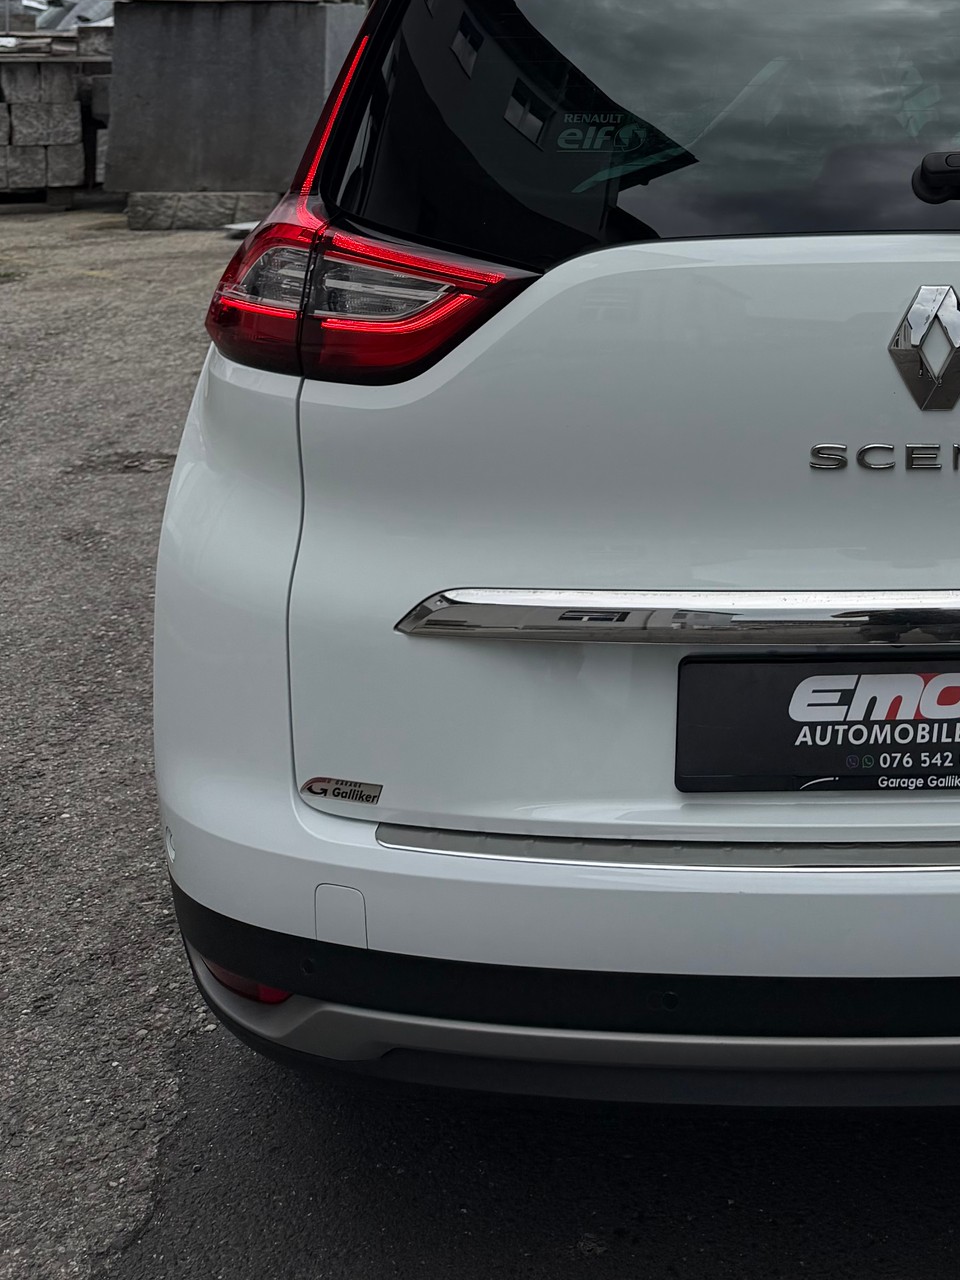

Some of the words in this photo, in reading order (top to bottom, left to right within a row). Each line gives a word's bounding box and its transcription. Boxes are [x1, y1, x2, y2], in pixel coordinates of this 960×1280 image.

[564, 114, 624, 123] RENAULT
[557, 126, 615, 149] elf
[879, 753, 913, 768] 076
[920, 752, 953, 767] 542
[878, 776, 924, 790] Garage
[332, 787, 377, 803] Galliker
